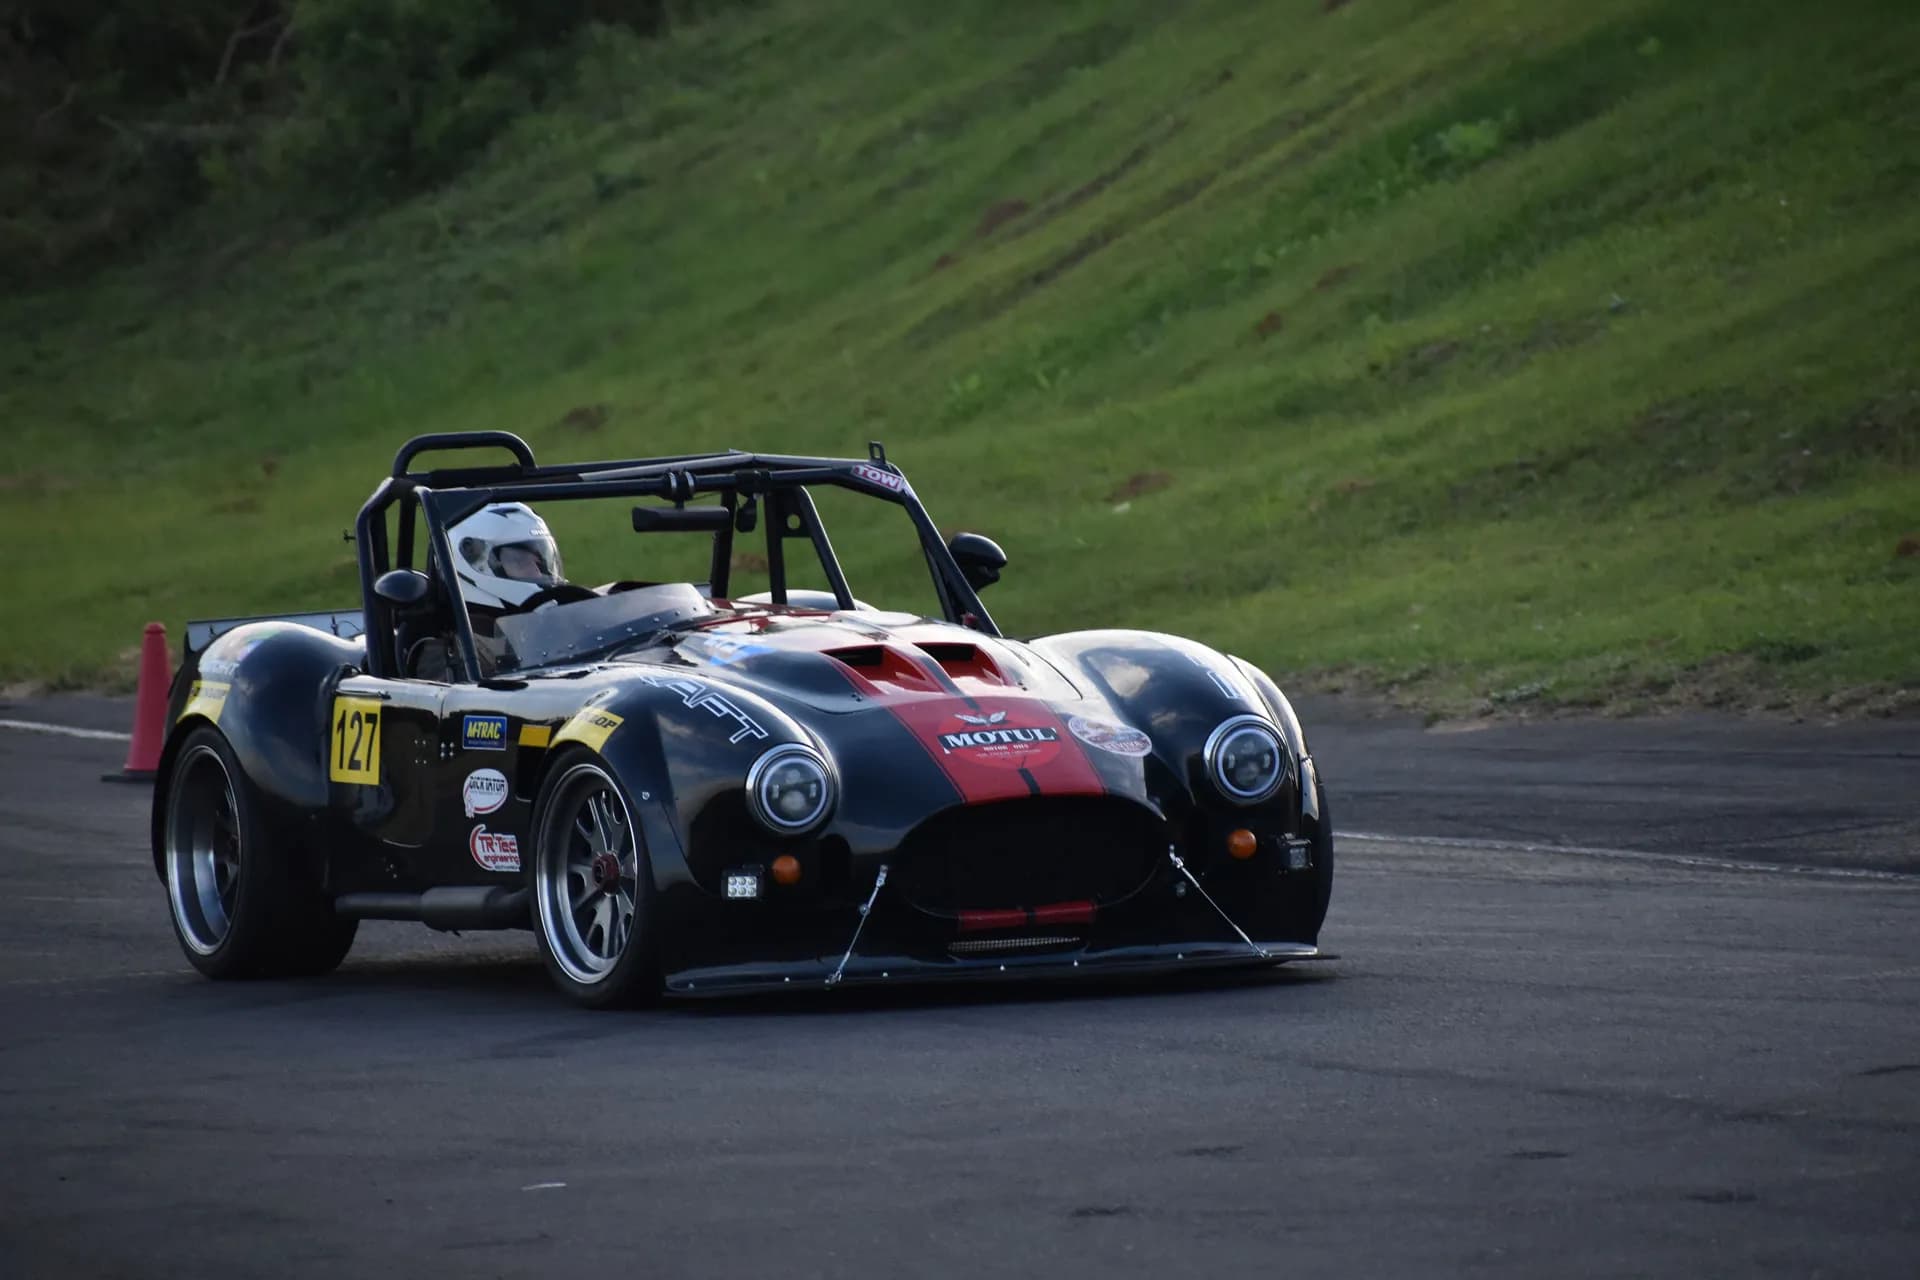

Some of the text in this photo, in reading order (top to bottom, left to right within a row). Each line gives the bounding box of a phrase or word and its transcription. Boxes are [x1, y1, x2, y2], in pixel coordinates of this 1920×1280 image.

[853, 465, 899, 488] TOW
[337, 709, 378, 772] 127
[944, 729, 1056, 748] MOTUL
